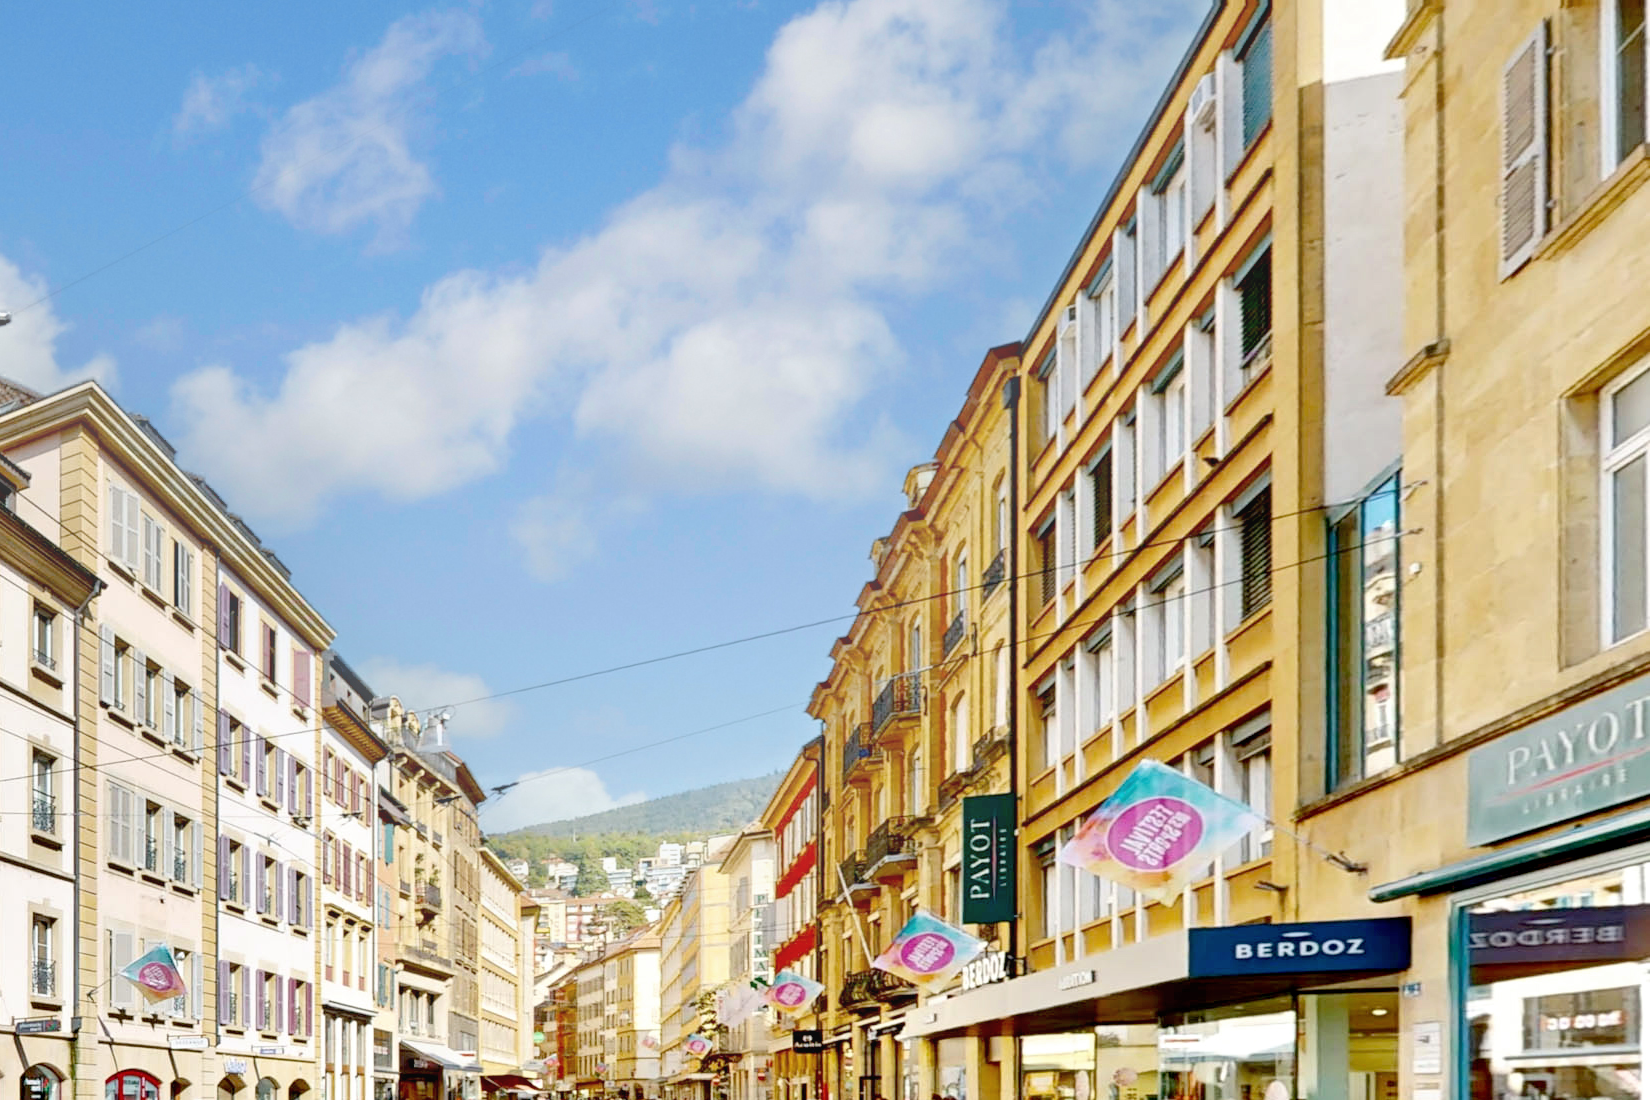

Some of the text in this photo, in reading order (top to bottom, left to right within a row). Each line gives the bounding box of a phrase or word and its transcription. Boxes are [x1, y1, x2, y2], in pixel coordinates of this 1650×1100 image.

[1507, 696, 1650, 786] PAYOT
[970, 818, 991, 899] PAYOT
[962, 951, 1007, 990] BERDOZ
[1235, 938, 1365, 960] BERDOZ
